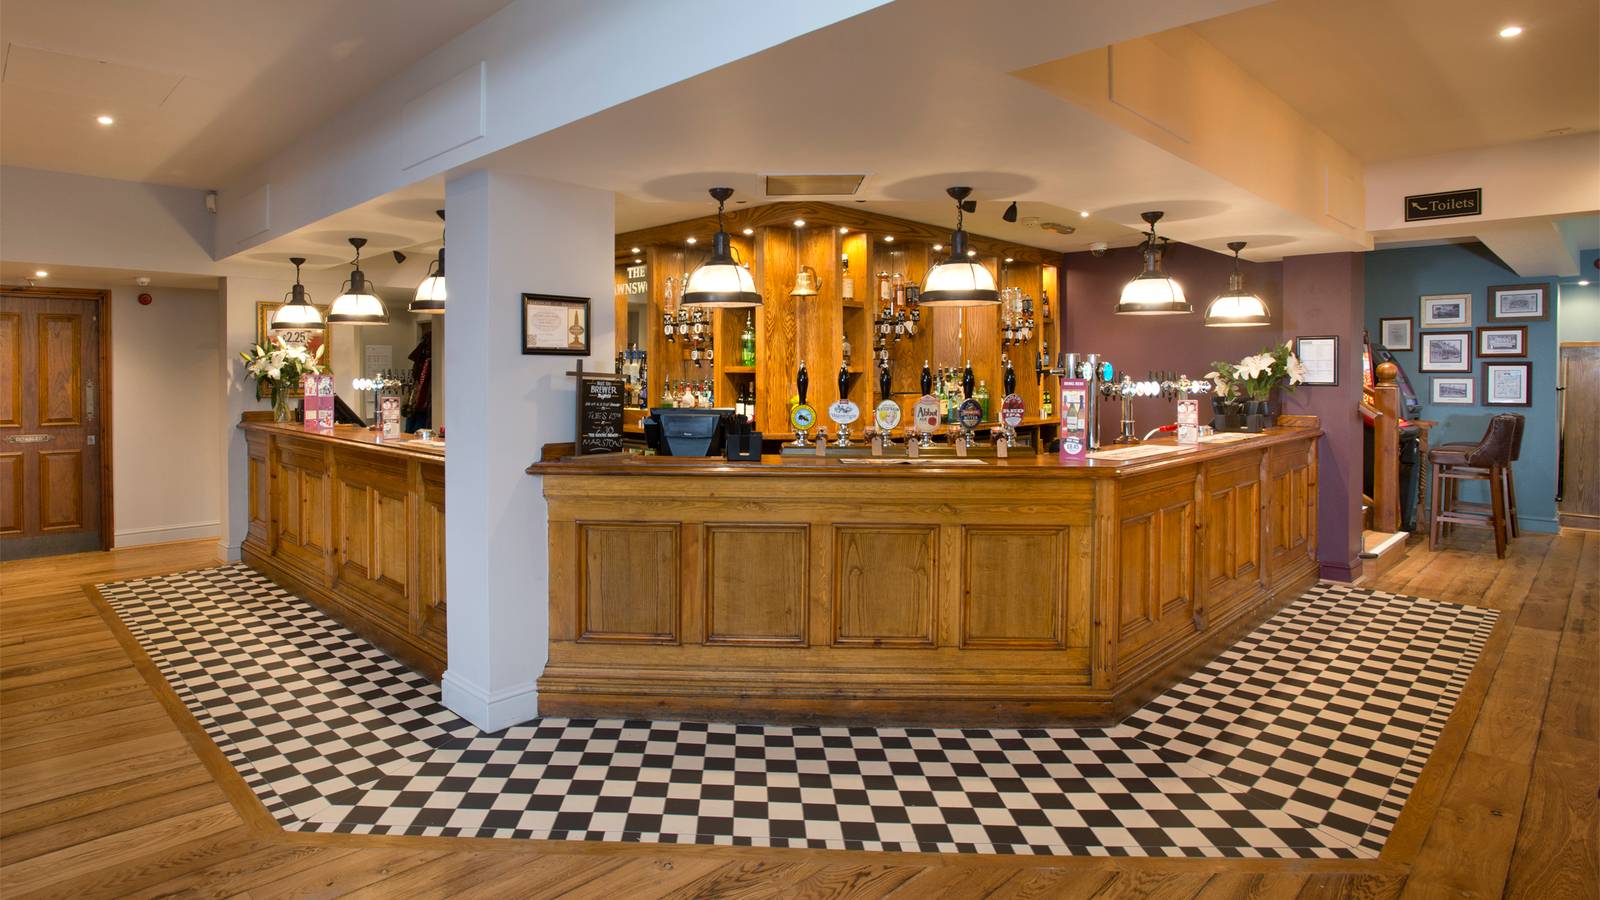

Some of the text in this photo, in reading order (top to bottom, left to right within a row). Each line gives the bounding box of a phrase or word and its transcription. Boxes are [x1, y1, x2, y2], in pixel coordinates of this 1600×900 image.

[1428, 198, 1475, 212] Toilets
[627, 265, 646, 279] THE
[615, 281, 648, 295] WNSW
[590, 385, 617, 394] BREWER
[917, 406, 938, 417] Abbot
